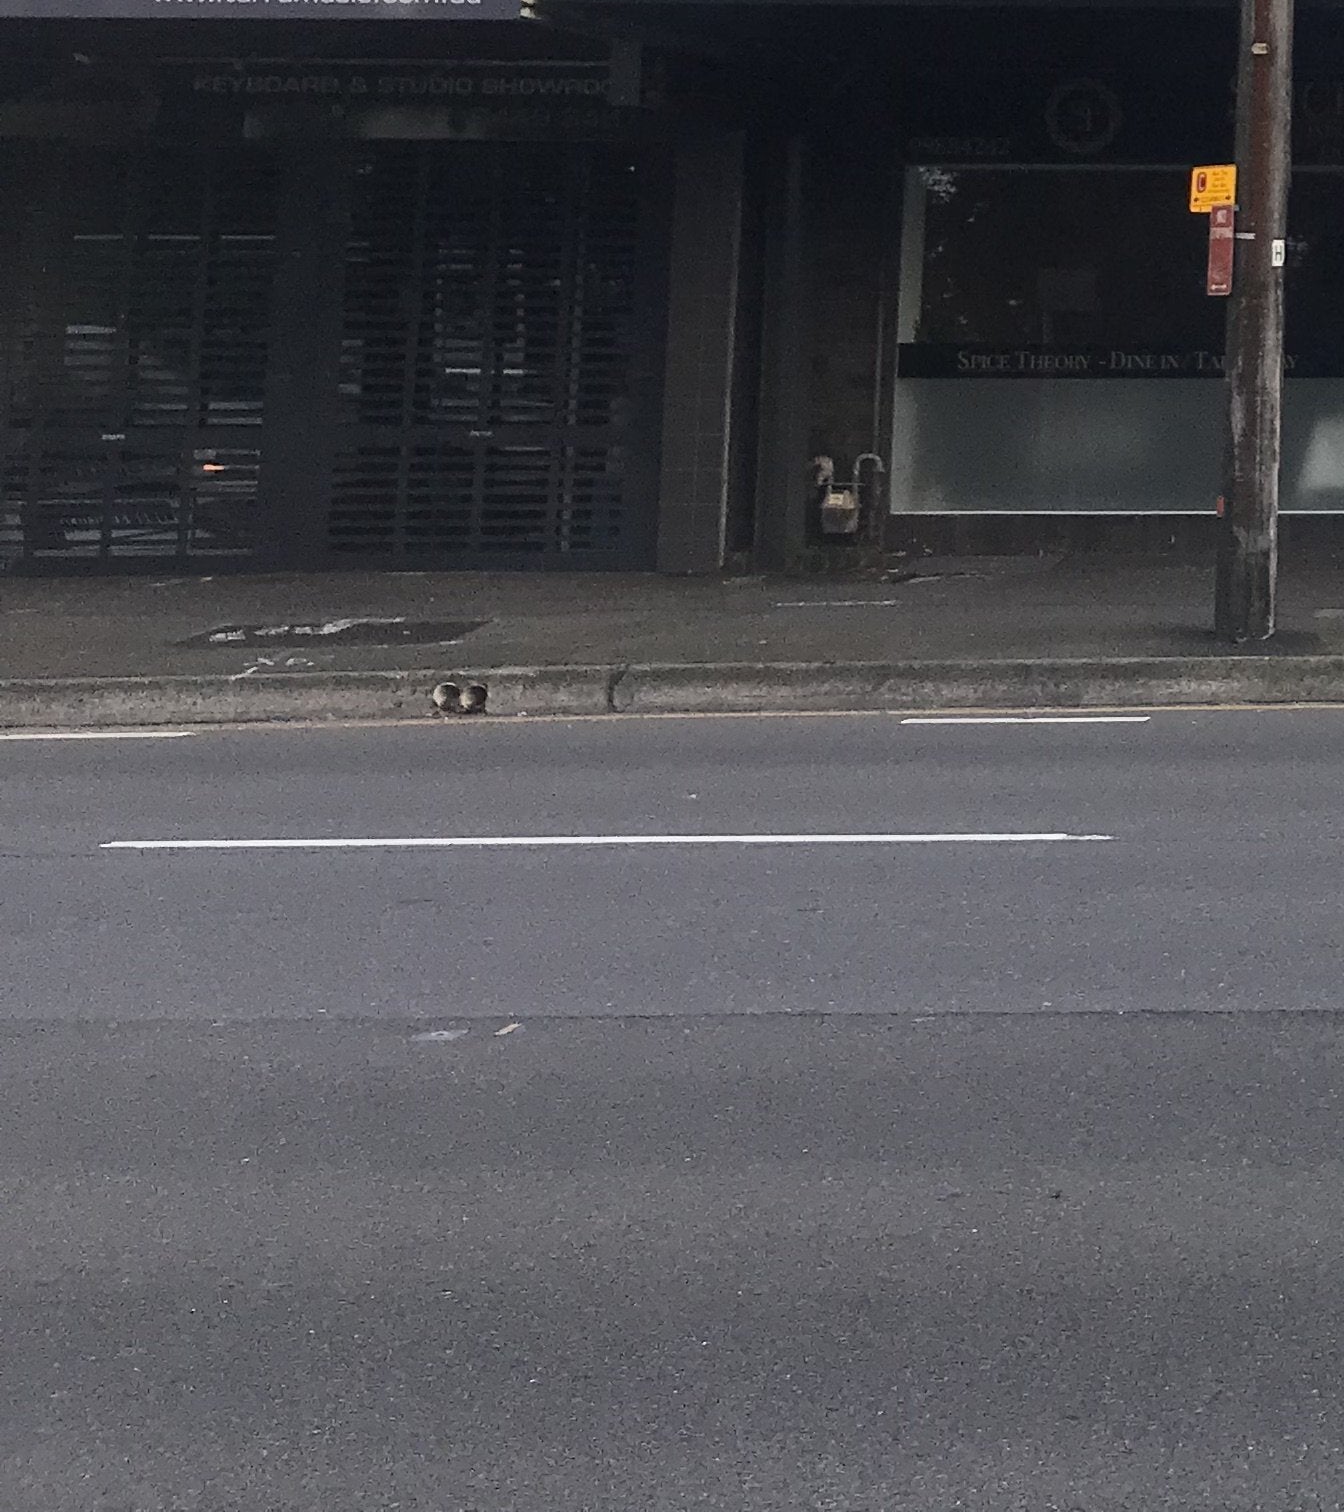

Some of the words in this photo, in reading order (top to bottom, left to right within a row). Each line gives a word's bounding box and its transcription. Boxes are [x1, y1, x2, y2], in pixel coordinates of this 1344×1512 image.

[193, 76, 340, 93] KEYBOARD
[350, 76, 368, 93] &
[378, 77, 473, 95] STUDIO
[957, 350, 1011, 370] SPICE
[1017, 350, 1091, 370] THEORY
[1109, 350, 1157, 370] DINE
